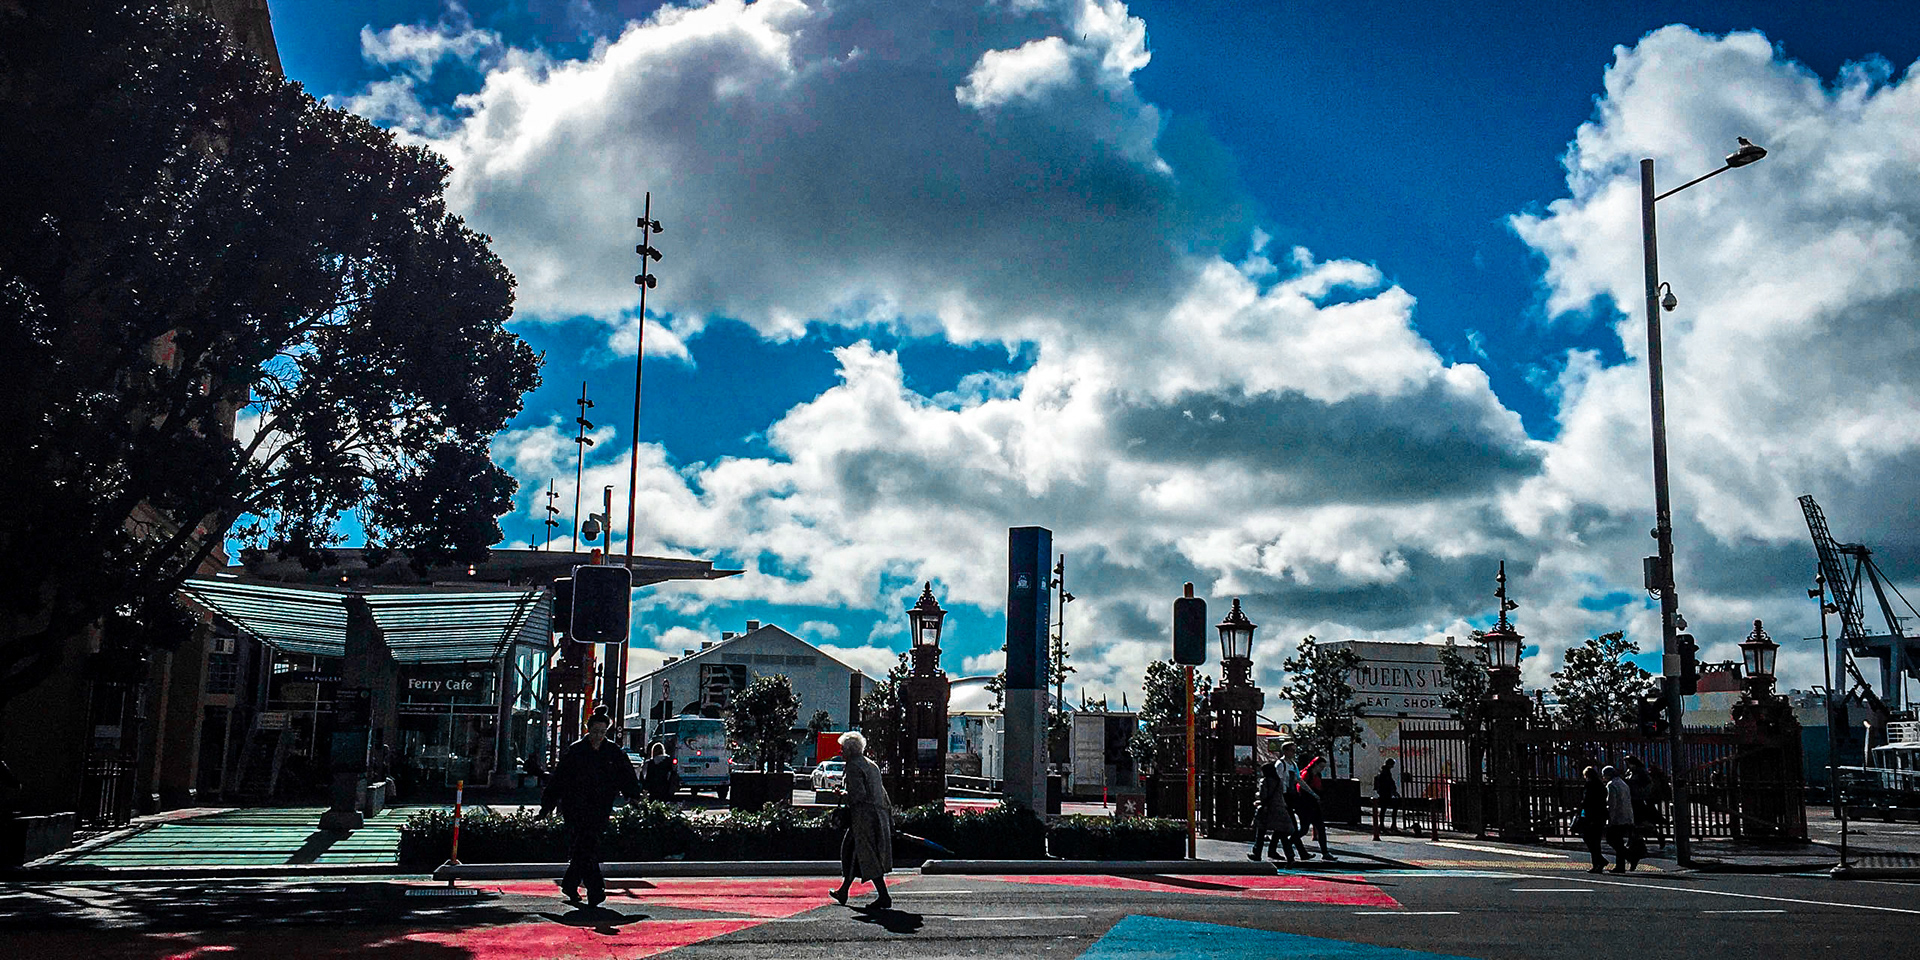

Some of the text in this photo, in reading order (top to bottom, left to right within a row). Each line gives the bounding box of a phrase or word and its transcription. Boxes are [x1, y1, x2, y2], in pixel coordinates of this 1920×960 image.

[408, 678, 473, 692] Ferry Cafe
[1356, 667, 1426, 689] QUEENS
[1367, 697, 1390, 707] EAT
[1403, 698, 1437, 709] SHOP
